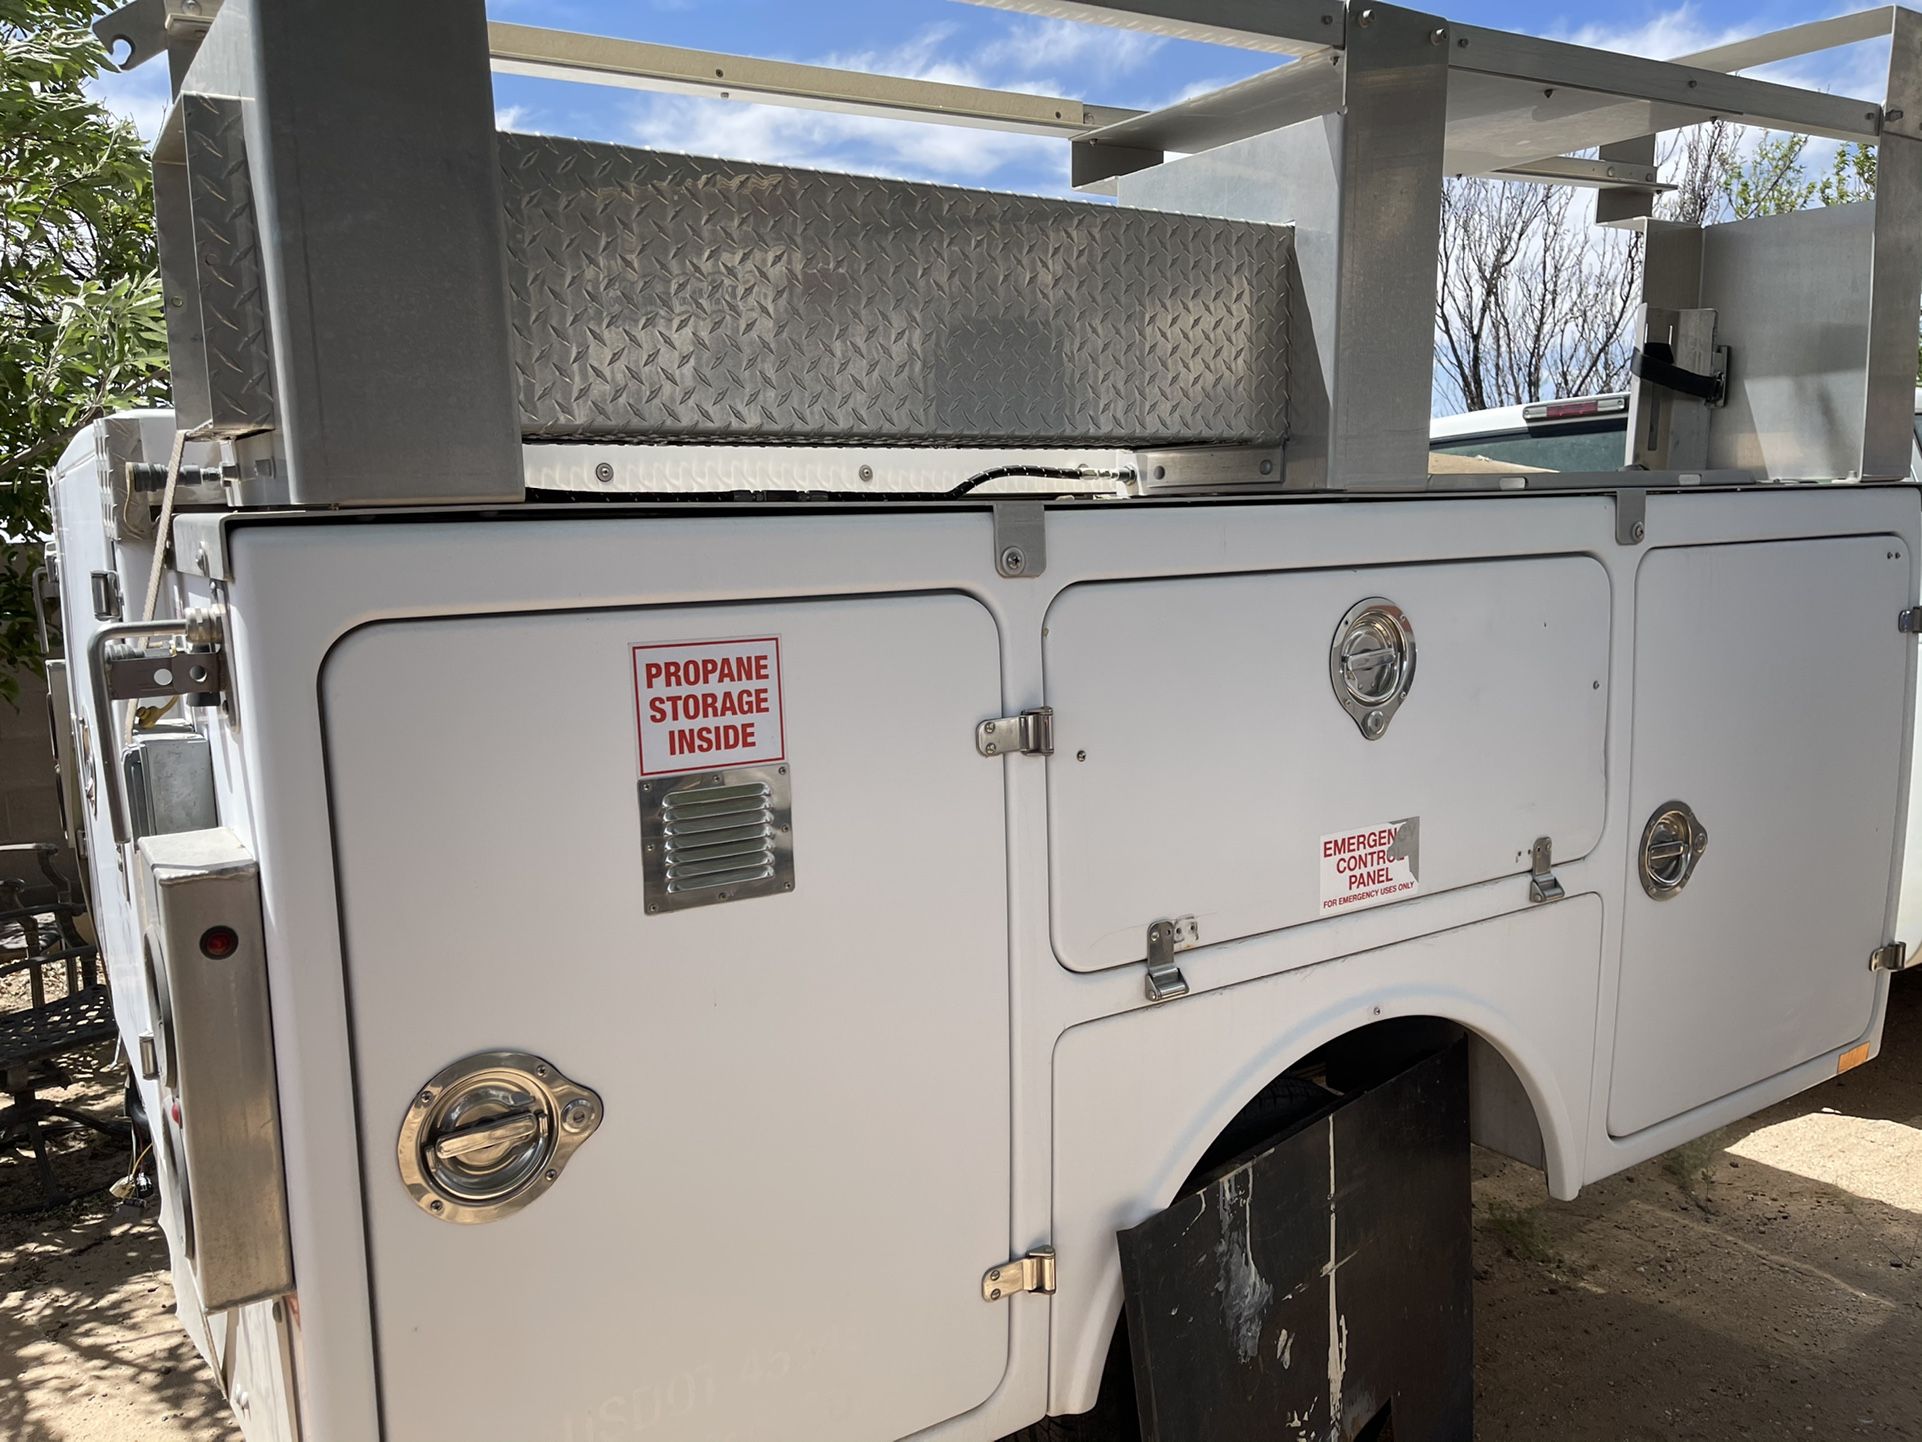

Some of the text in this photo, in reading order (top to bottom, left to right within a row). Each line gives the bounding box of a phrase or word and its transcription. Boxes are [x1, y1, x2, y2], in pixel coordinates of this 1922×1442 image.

[645, 655, 769, 689] PROPANE
[649, 688, 769, 723] STORAGE
[668, 723, 756, 756] INSIDE
[1323, 827, 1398, 858] EMERGEN
[1336, 849, 1405, 874] CONTR
[1349, 867, 1394, 891] PANEL
[1323, 881, 1415, 909] FOR EMERGENCY USES ONLY
